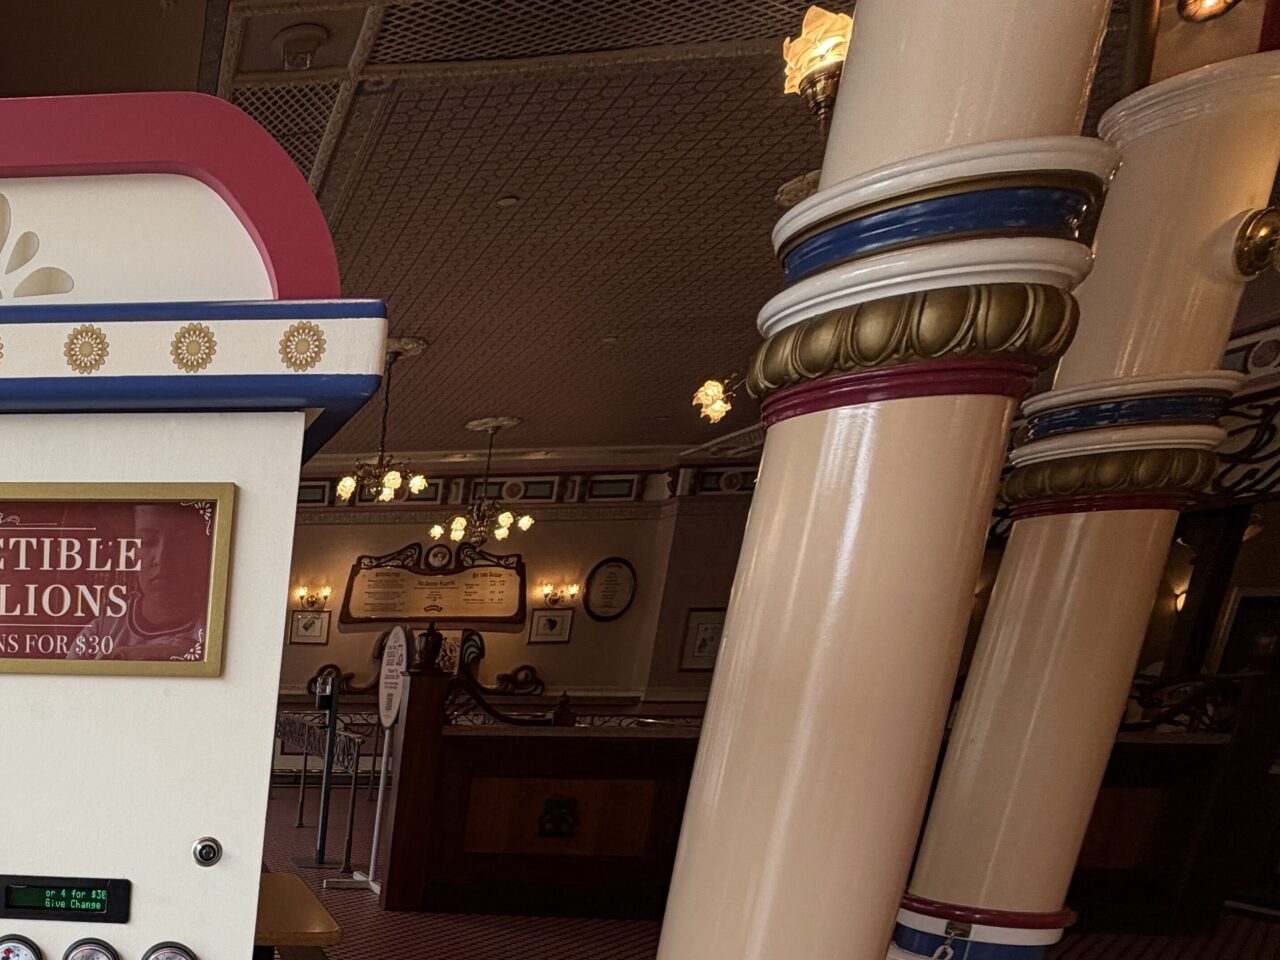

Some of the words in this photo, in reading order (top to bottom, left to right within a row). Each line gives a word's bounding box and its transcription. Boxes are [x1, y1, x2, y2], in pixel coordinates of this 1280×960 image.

[25, 633, 69, 654] FOR
[75, 633, 114, 657] $30
[60, 889, 66, 898] 4
[71, 889, 86, 899] for
[45, 898, 66, 908] Give
[70, 899, 101, 910] Change
